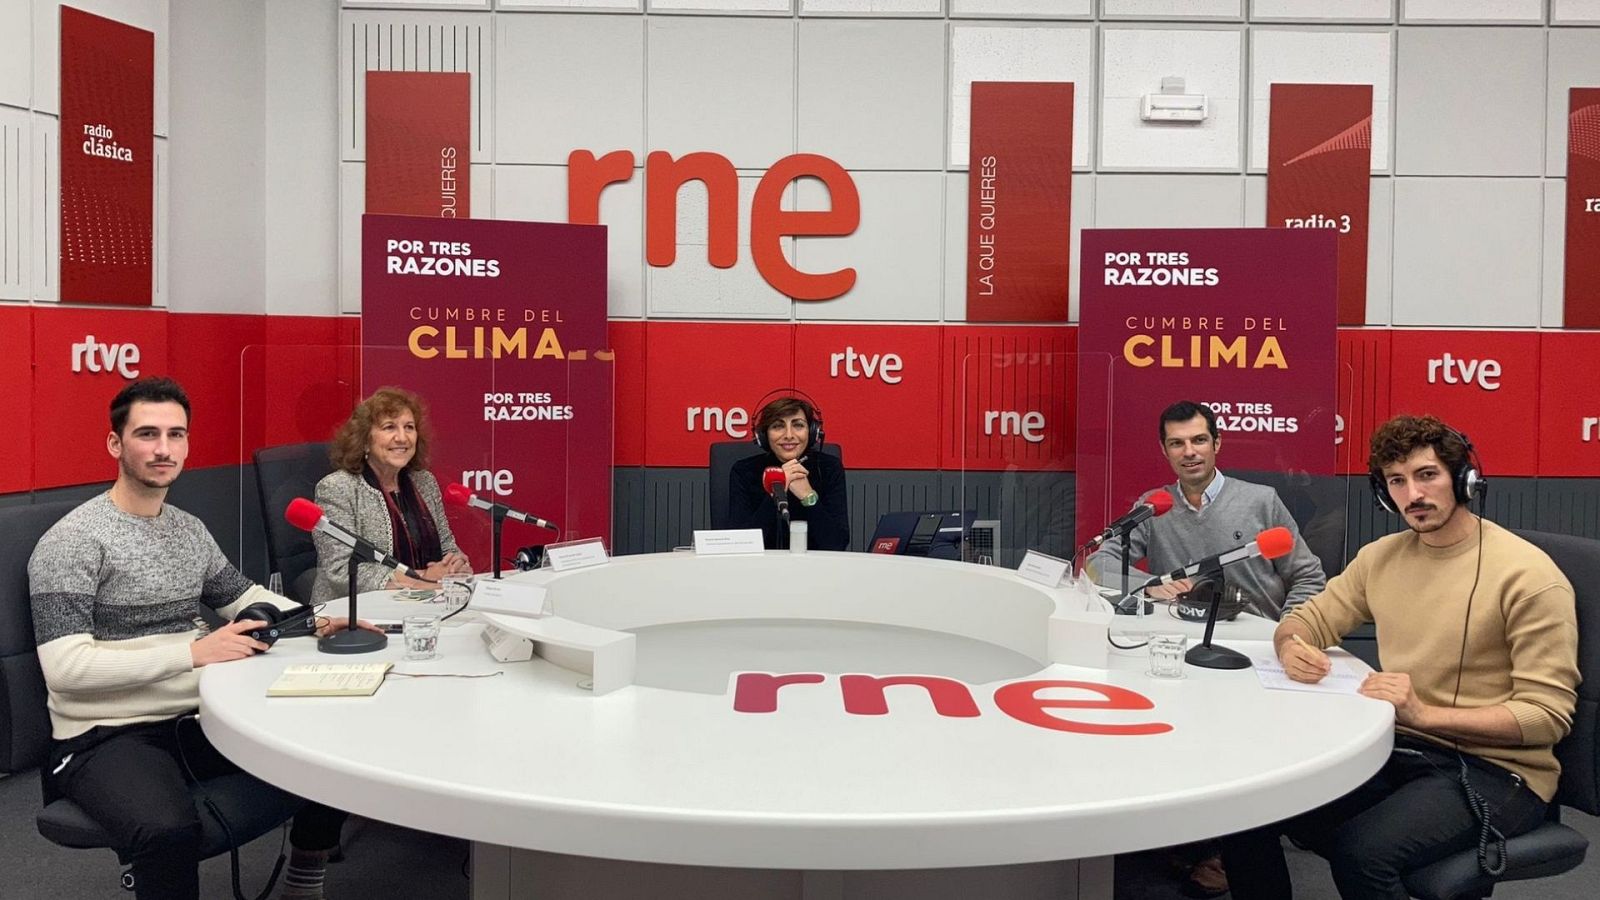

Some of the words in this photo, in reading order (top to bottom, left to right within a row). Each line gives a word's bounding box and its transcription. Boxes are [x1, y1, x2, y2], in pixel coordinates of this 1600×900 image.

[83, 124, 112, 139] radio
[83, 137, 133, 161] clásica
[441, 147, 456, 218] QUIERES
[980, 156, 996, 230] QUIERES
[568, 149, 860, 301] rne
[1285, 214, 1336, 228] radio
[1340, 215, 1351, 233] 3
[387, 239, 424, 253] POR
[429, 241, 471, 255] TRES
[979, 234, 994, 270] QUE
[1105, 252, 1141, 265] POR
[1146, 252, 1189, 265] TRES
[387, 256, 500, 277] RAZONES
[1104, 268, 1219, 286] RAZONES
[979, 274, 993, 295] LA
[410, 306, 505, 321] CUMBRE
[525, 309, 563, 323] DEL
[1126, 316, 1224, 330] CUMBRE
[1244, 317, 1287, 330] DEL
[408, 325, 565, 360] CLIMA
[1123, 334, 1288, 369] CLIMA
[72, 335, 140, 379] rtve
[831, 346, 903, 384] rtve
[1428, 352, 1501, 390] rtve
[484, 393, 514, 404] POR
[517, 393, 552, 404] TRES
[1236, 403, 1273, 415] TRES
[484, 405, 574, 421] RAZONES
[687, 406, 749, 438] rne
[1215, 416, 1299, 433] AZONES
[985, 411, 1046, 442] rne
[462, 468, 514, 496] rne
[733, 673, 1174, 735] rne
